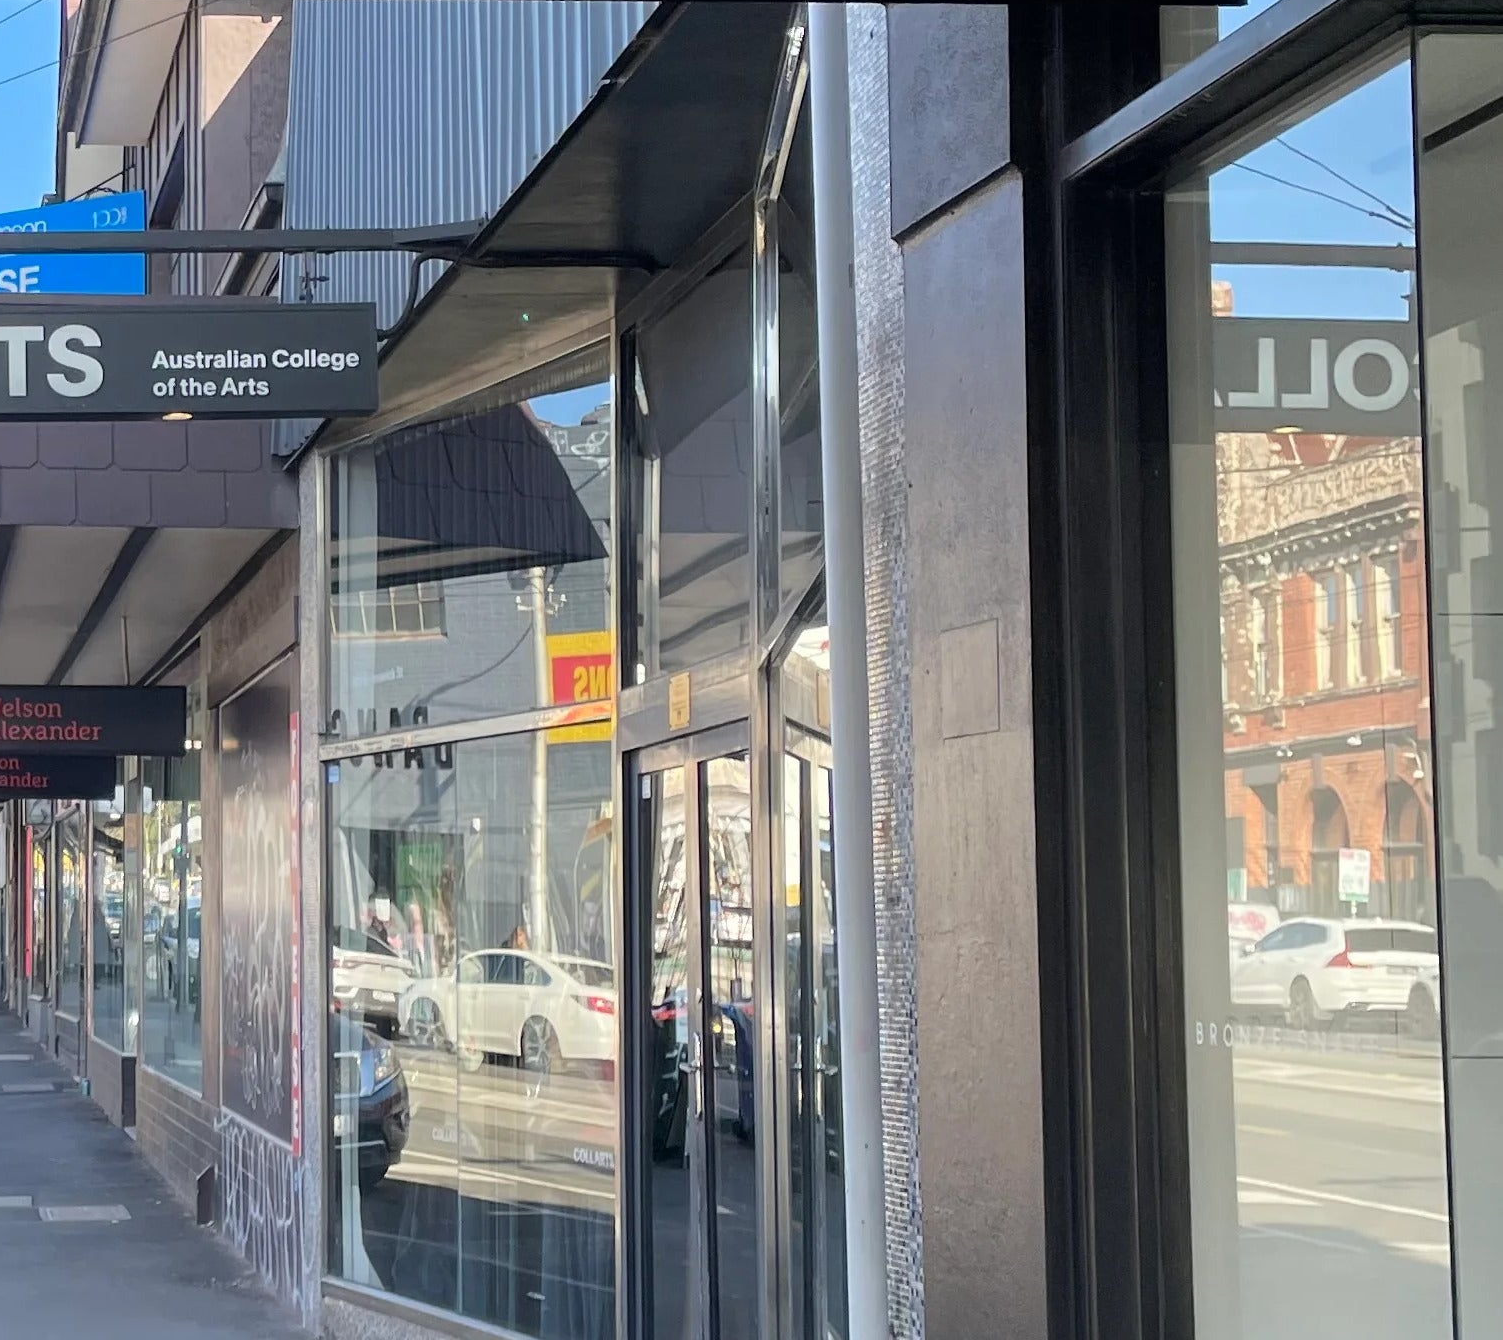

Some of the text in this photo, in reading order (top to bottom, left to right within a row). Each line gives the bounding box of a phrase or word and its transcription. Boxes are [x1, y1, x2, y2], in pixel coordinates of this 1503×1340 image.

[151, 348, 360, 371] Australian College
[152, 377, 270, 396] of the Arts
[1195, 1020, 1282, 1049] BRONZE
